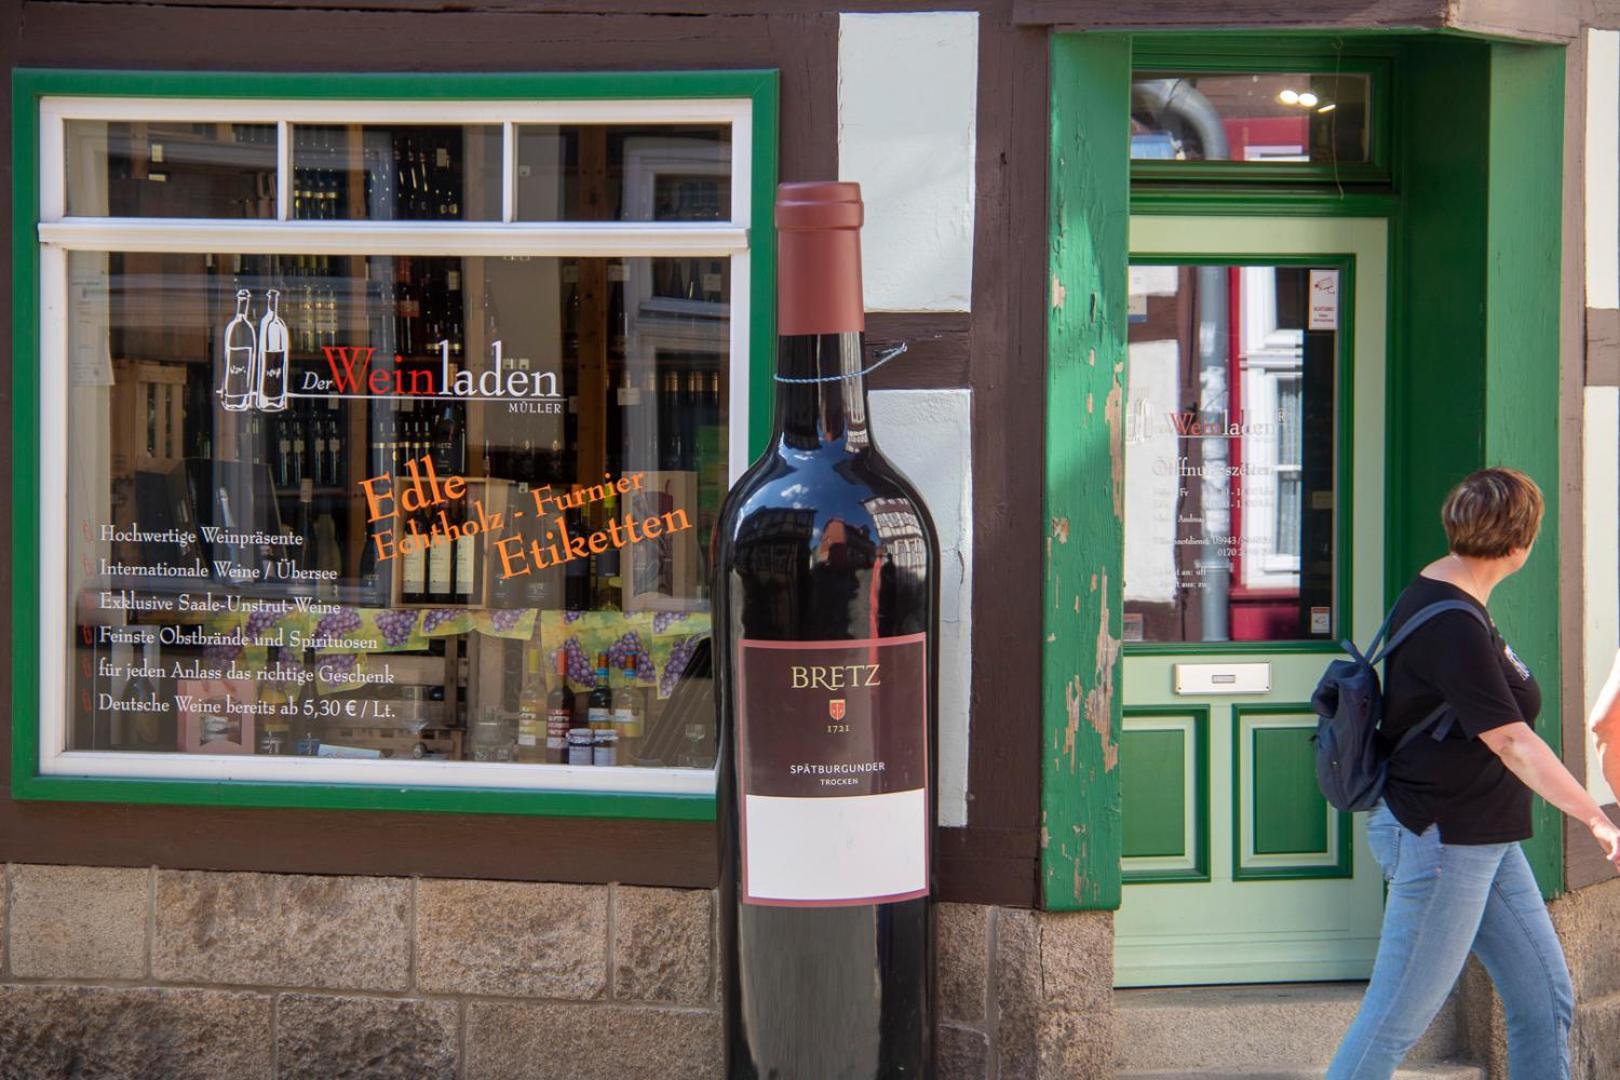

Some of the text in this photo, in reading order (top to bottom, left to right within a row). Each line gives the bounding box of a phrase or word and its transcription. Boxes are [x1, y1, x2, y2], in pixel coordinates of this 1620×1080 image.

[302, 340, 561, 397] Der Weinladen
[508, 400, 562, 414] MÜLLER
[358, 454, 467, 523] Edle
[371, 500, 505, 561] Echtholz
[530, 471, 645, 517] Furnier
[100, 523, 303, 549] Hochwertige Weinpräsente
[493, 507, 693, 580] Etiketten
[100, 558, 208, 578] Internationale
[214, 560, 260, 579] Weine
[277, 558, 338, 580] Übersee
[100, 591, 341, 615] Exklusive Saale-Unstrut-Weine
[99, 625, 378, 651] Feinste Obstbrände und Spirituosen
[98, 657, 394, 686] für jeden Anlass das richtige Geschenk
[791, 664, 880, 691] BRETZ
[99, 694, 169, 713] Deutsche
[174, 695, 220, 715] Weine
[226, 695, 275, 716] bereits
[280, 696, 298, 716] ab
[303, 699, 340, 719] 5,30
[345, 700, 357, 717] €
[374, 700, 396, 719] Lt.
[827, 725, 850, 733] 1721
[790, 761, 886, 775] SPÄTBURGUNDER
[820, 778, 858, 786] TROCKEN
